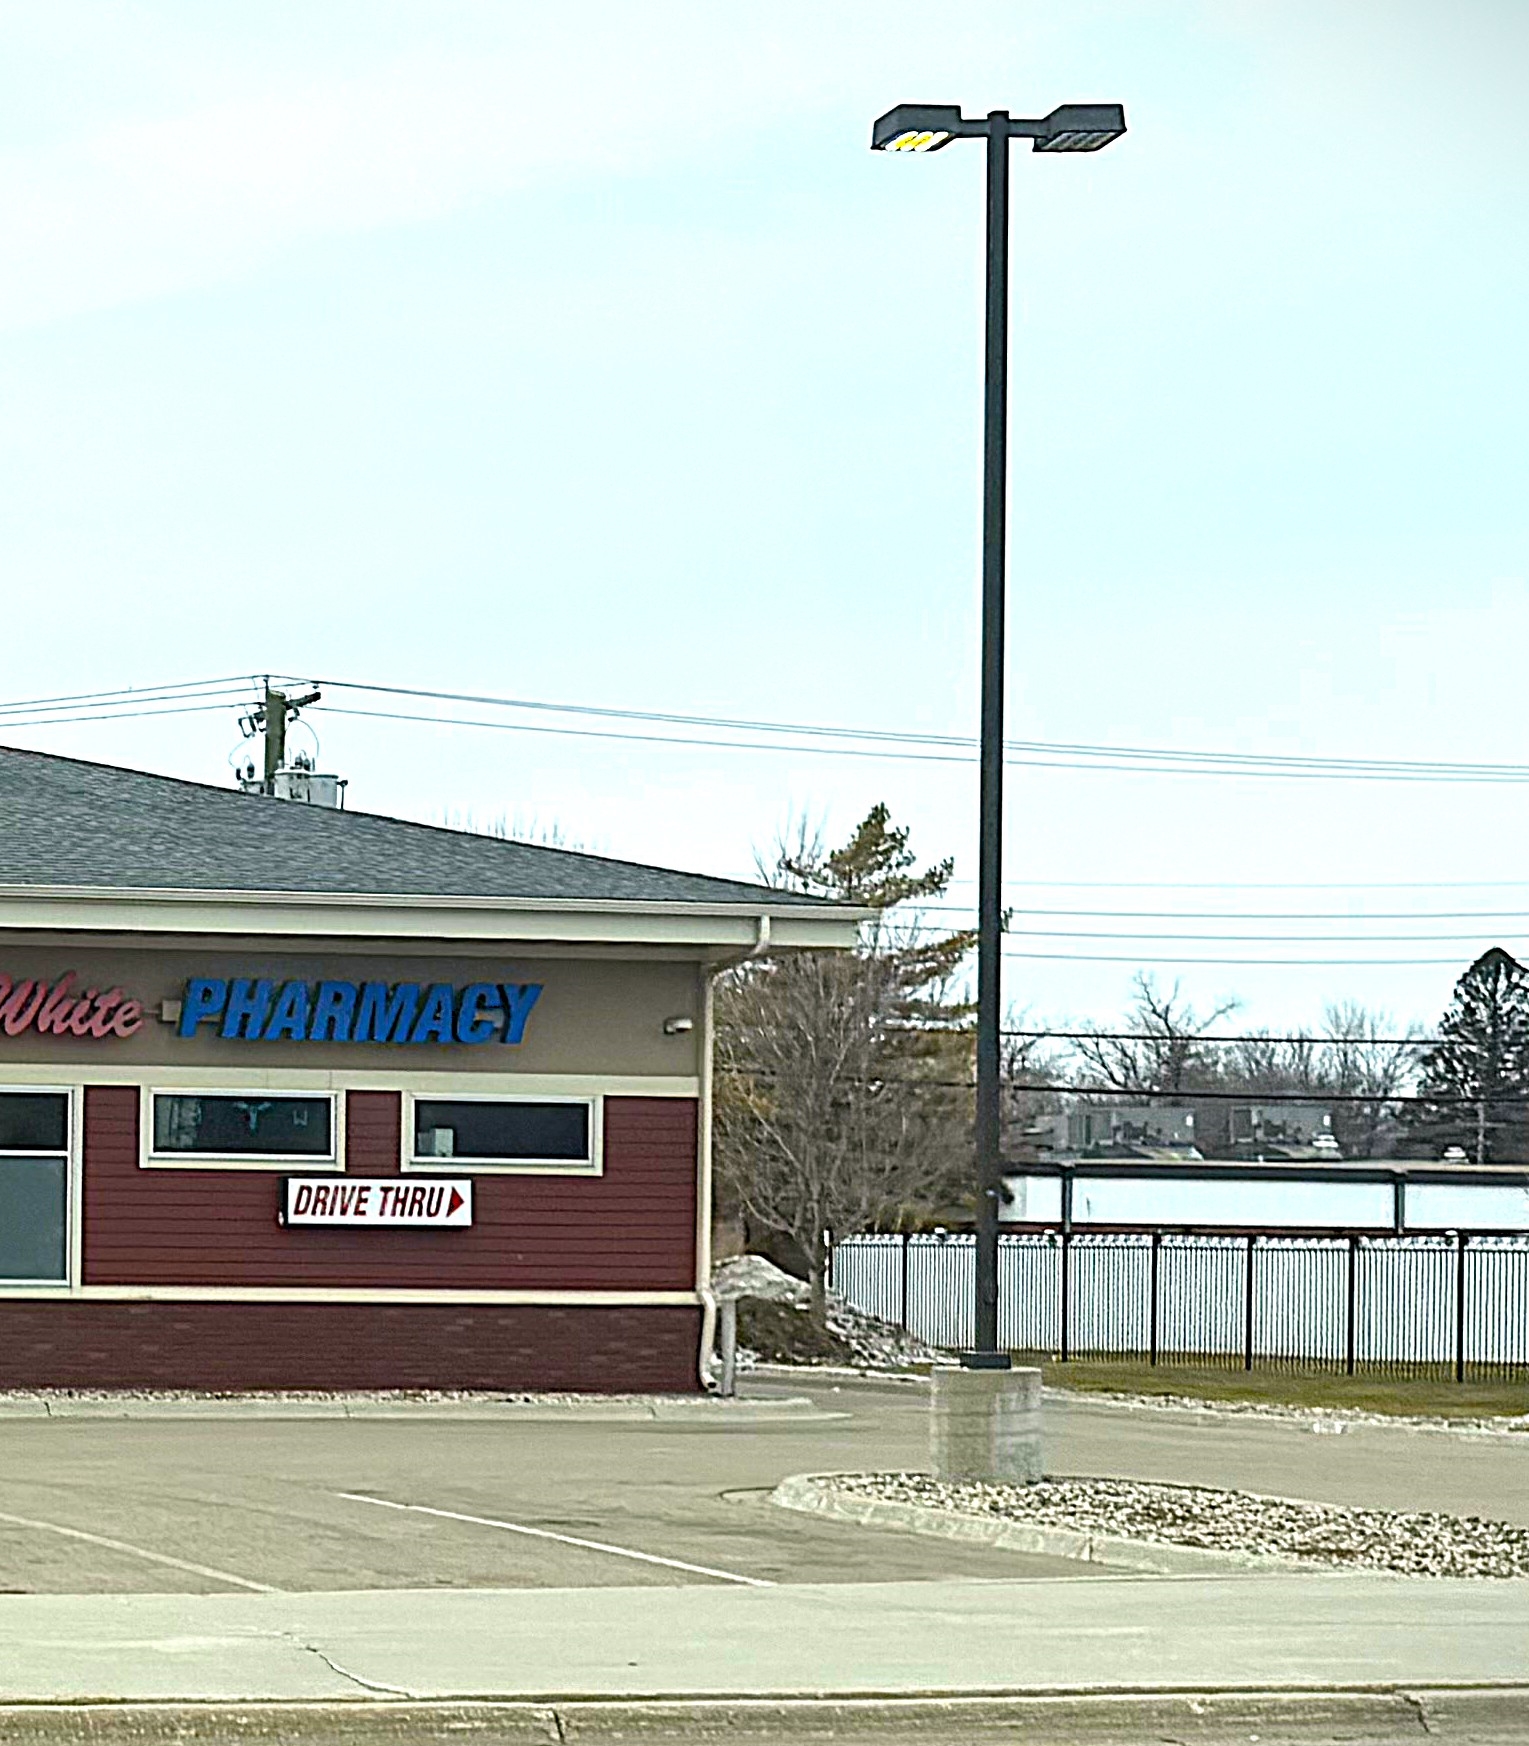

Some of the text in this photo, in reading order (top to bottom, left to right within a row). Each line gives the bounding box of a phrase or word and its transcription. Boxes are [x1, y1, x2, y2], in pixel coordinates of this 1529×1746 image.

[178, 977, 543, 1044] PHARMACY
[293, 1185, 445, 1217] DRIVE THRU
